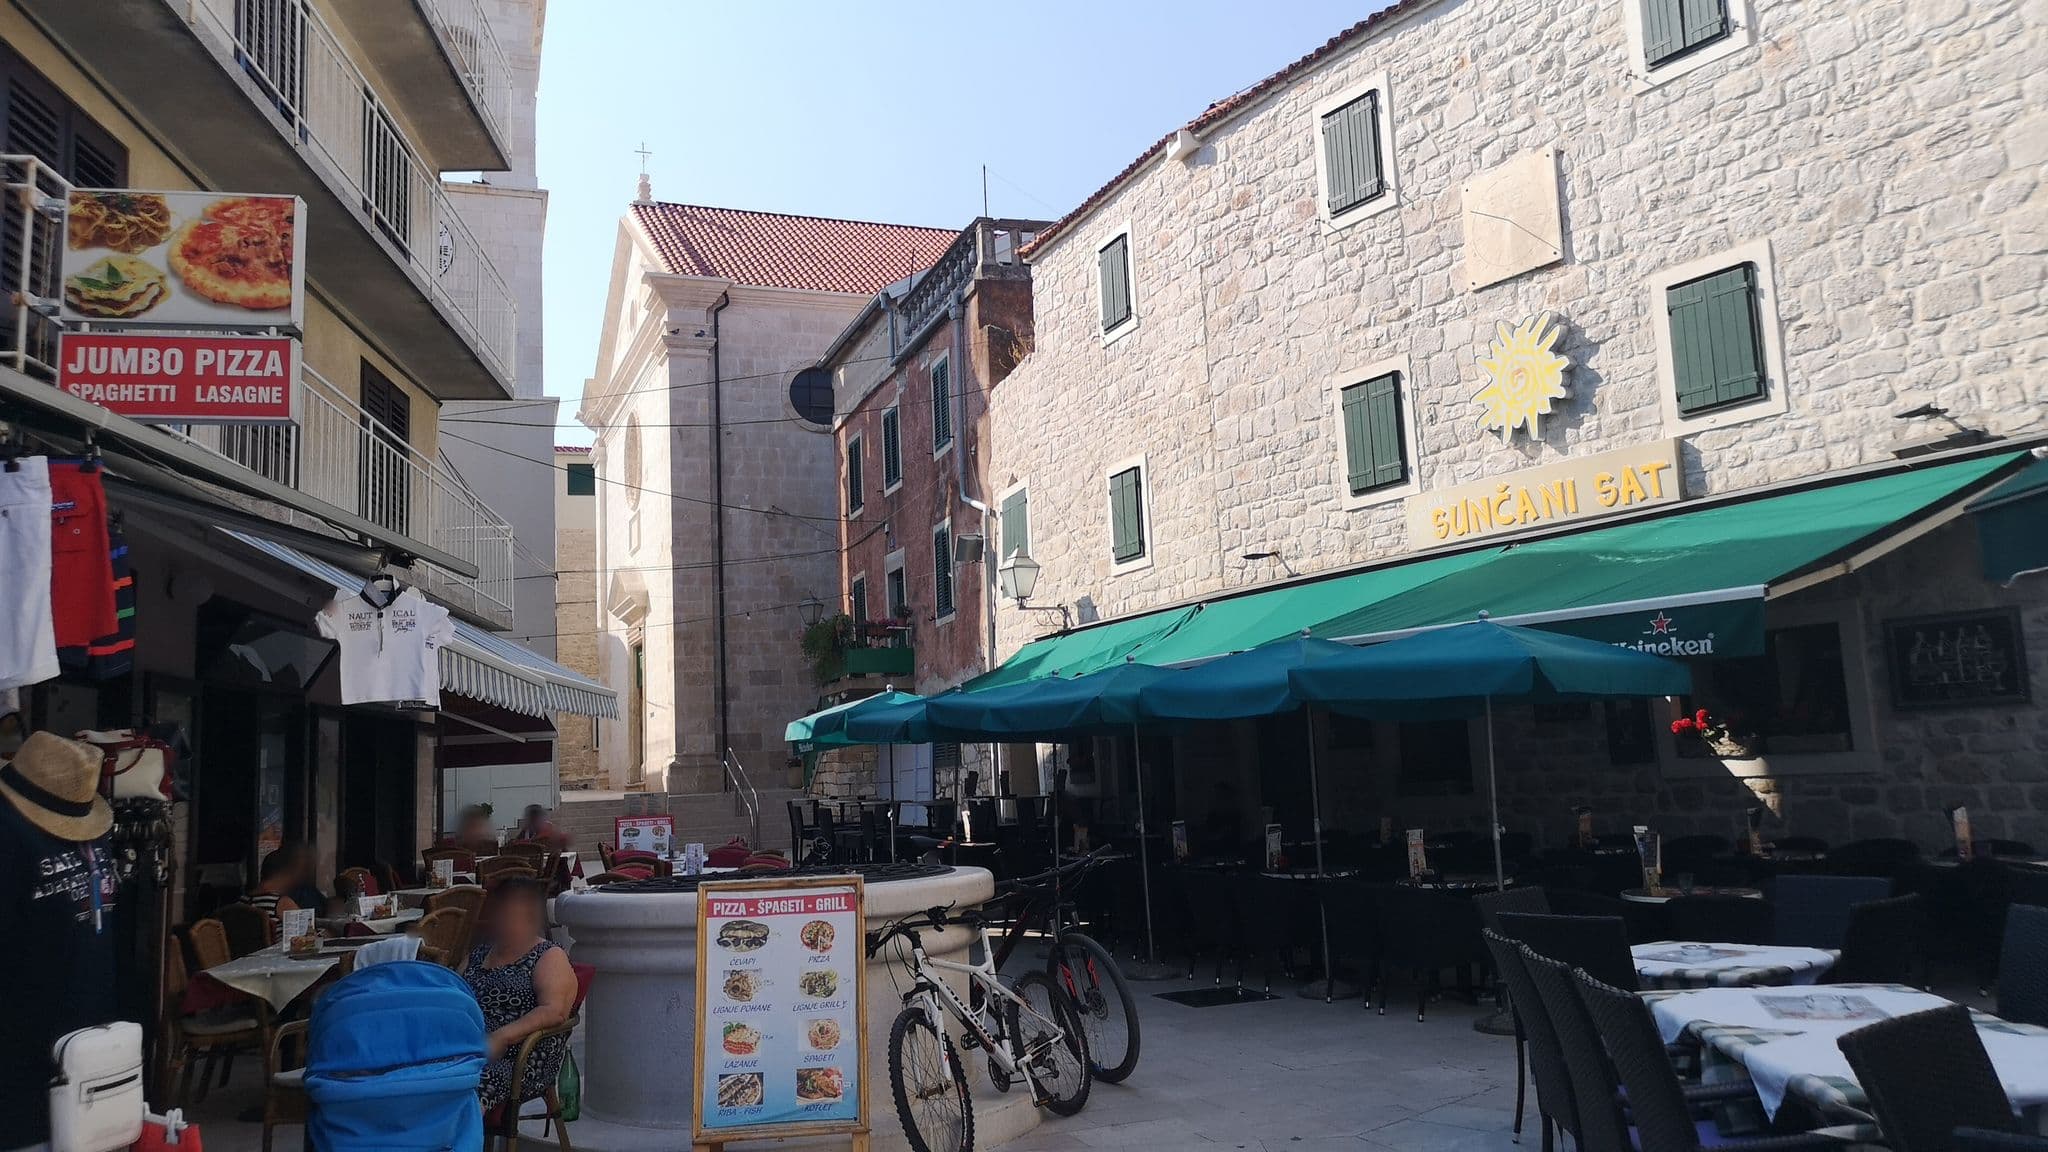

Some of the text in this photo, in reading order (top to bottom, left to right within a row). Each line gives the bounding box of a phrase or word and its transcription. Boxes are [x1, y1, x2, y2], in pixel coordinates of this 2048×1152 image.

[68, 347, 284, 377] JUMBO PIZZA
[68, 383, 282, 404] SPAGHETTI LASAGNE
[1431, 461, 1671, 539] SUNČANI SAT
[713, 902, 746, 916] PIZZA
[757, 899, 805, 914] ŠPAGETI
[815, 896, 848, 911] GRILL
